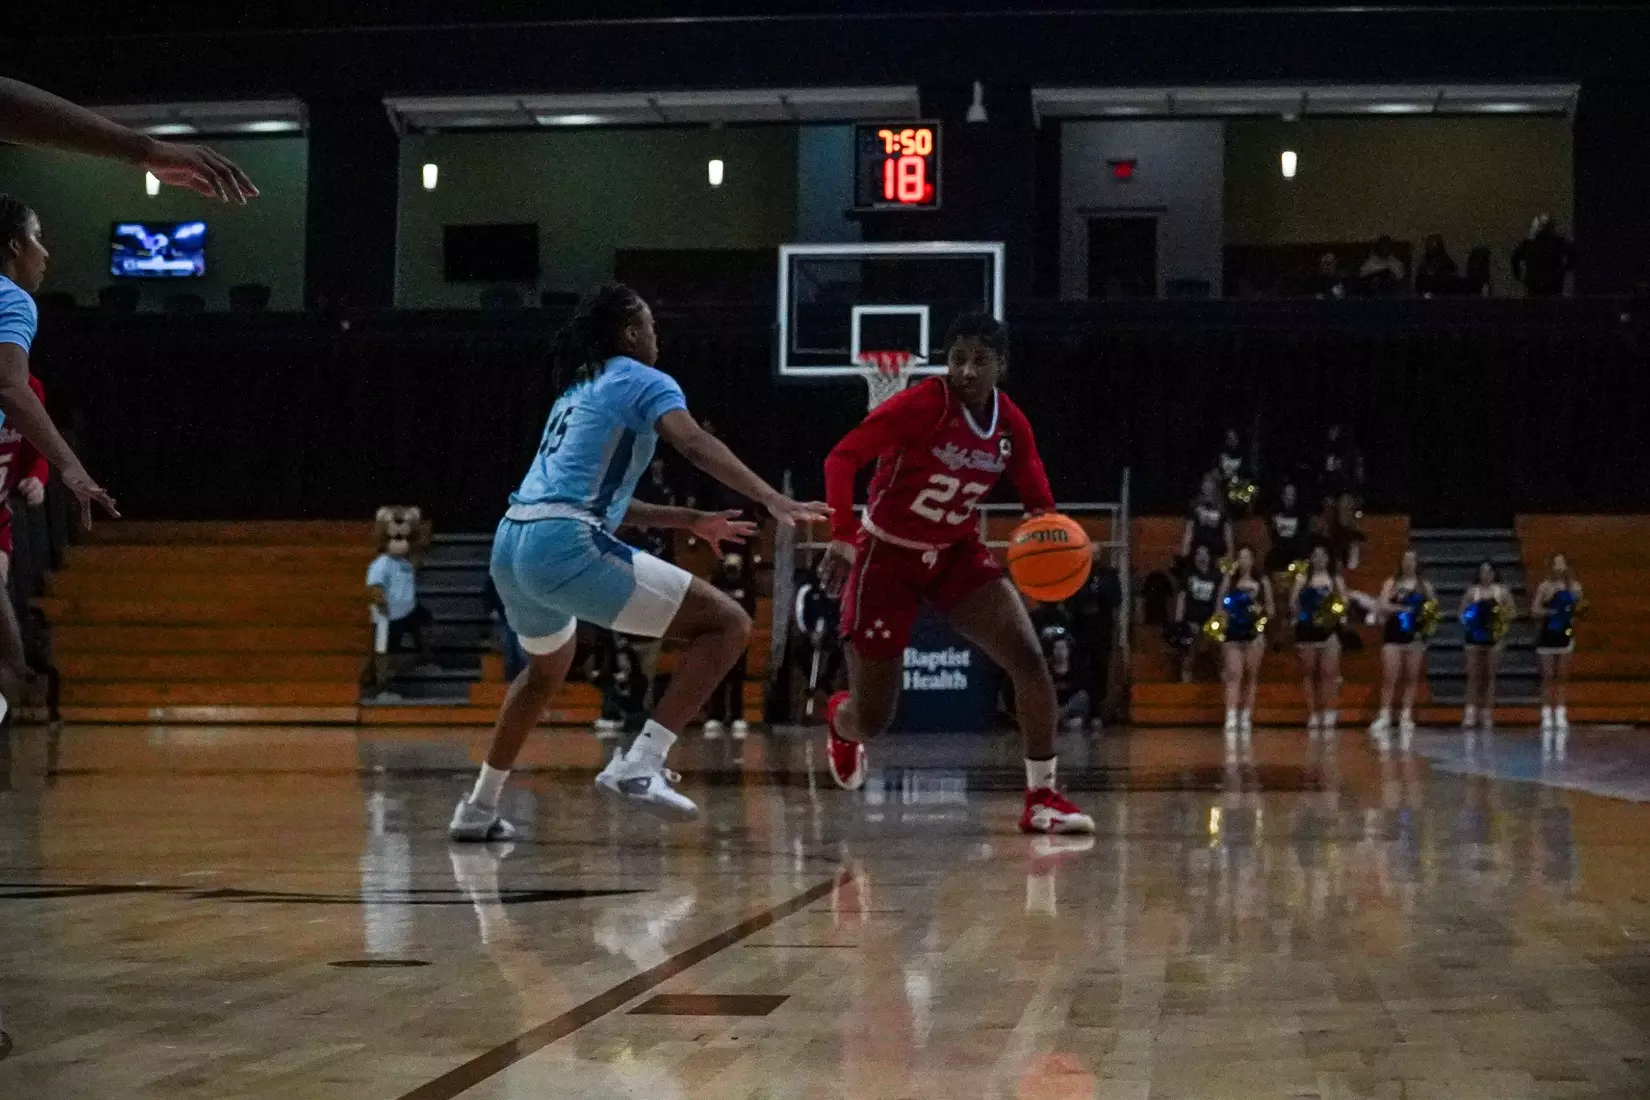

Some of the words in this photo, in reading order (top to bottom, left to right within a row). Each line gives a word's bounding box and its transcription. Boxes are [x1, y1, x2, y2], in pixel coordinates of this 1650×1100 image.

[878, 128, 932, 156] 7:50
[884, 156, 925, 202] 18
[909, 473, 990, 525] 23
[903, 646, 972, 673] Baptist
[903, 669, 969, 691] Health
